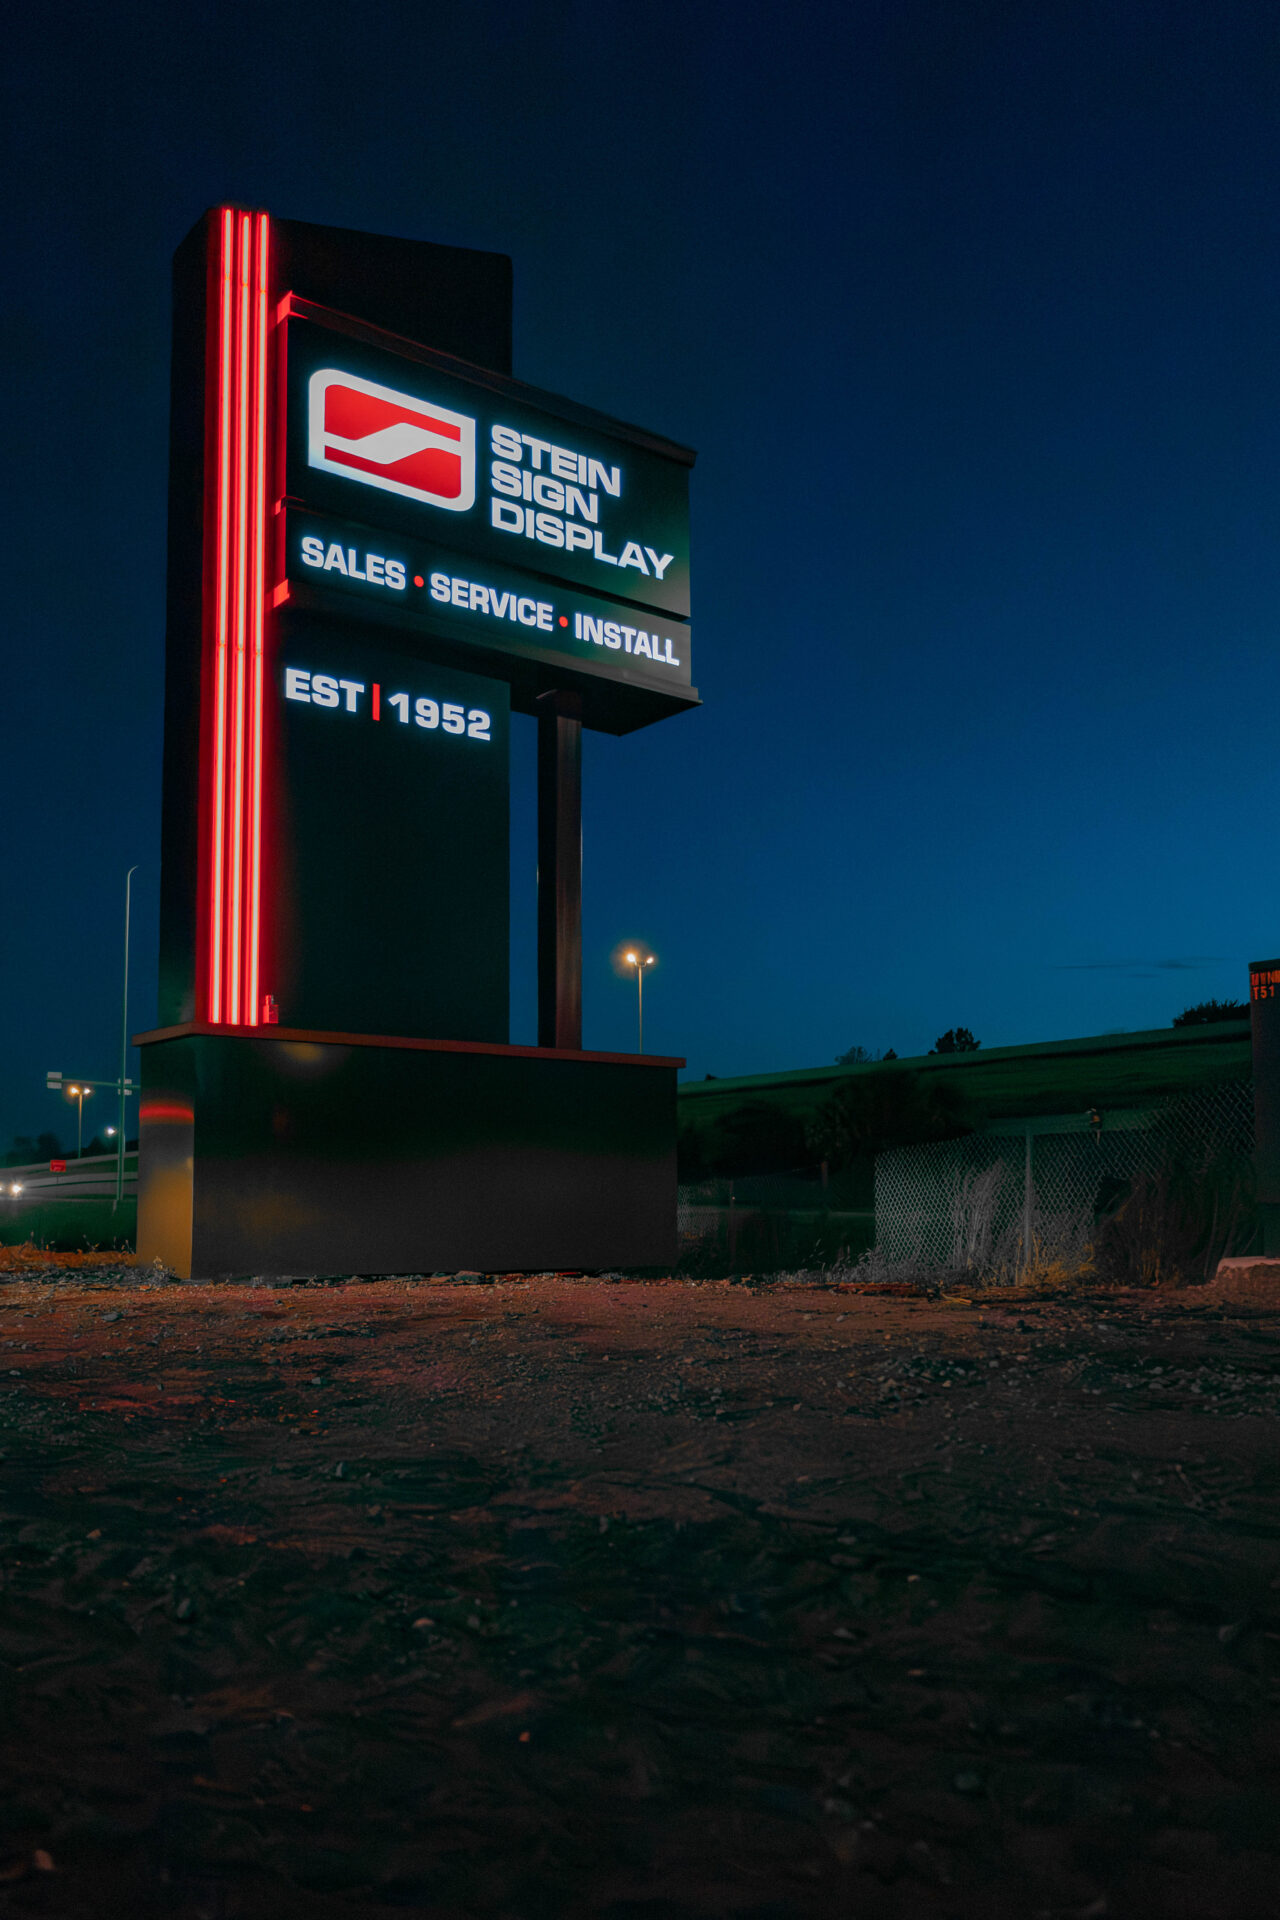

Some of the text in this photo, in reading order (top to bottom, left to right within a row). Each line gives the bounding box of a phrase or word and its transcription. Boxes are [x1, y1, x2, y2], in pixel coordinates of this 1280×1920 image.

[490, 424, 622, 498] STEIN
[490, 460, 599, 525] SIGN
[490, 496, 675, 581] DISPLAY
[300, 535, 681, 668] SALES SERVICE INSTALL
[284, 667, 492, 742] EST 1952
